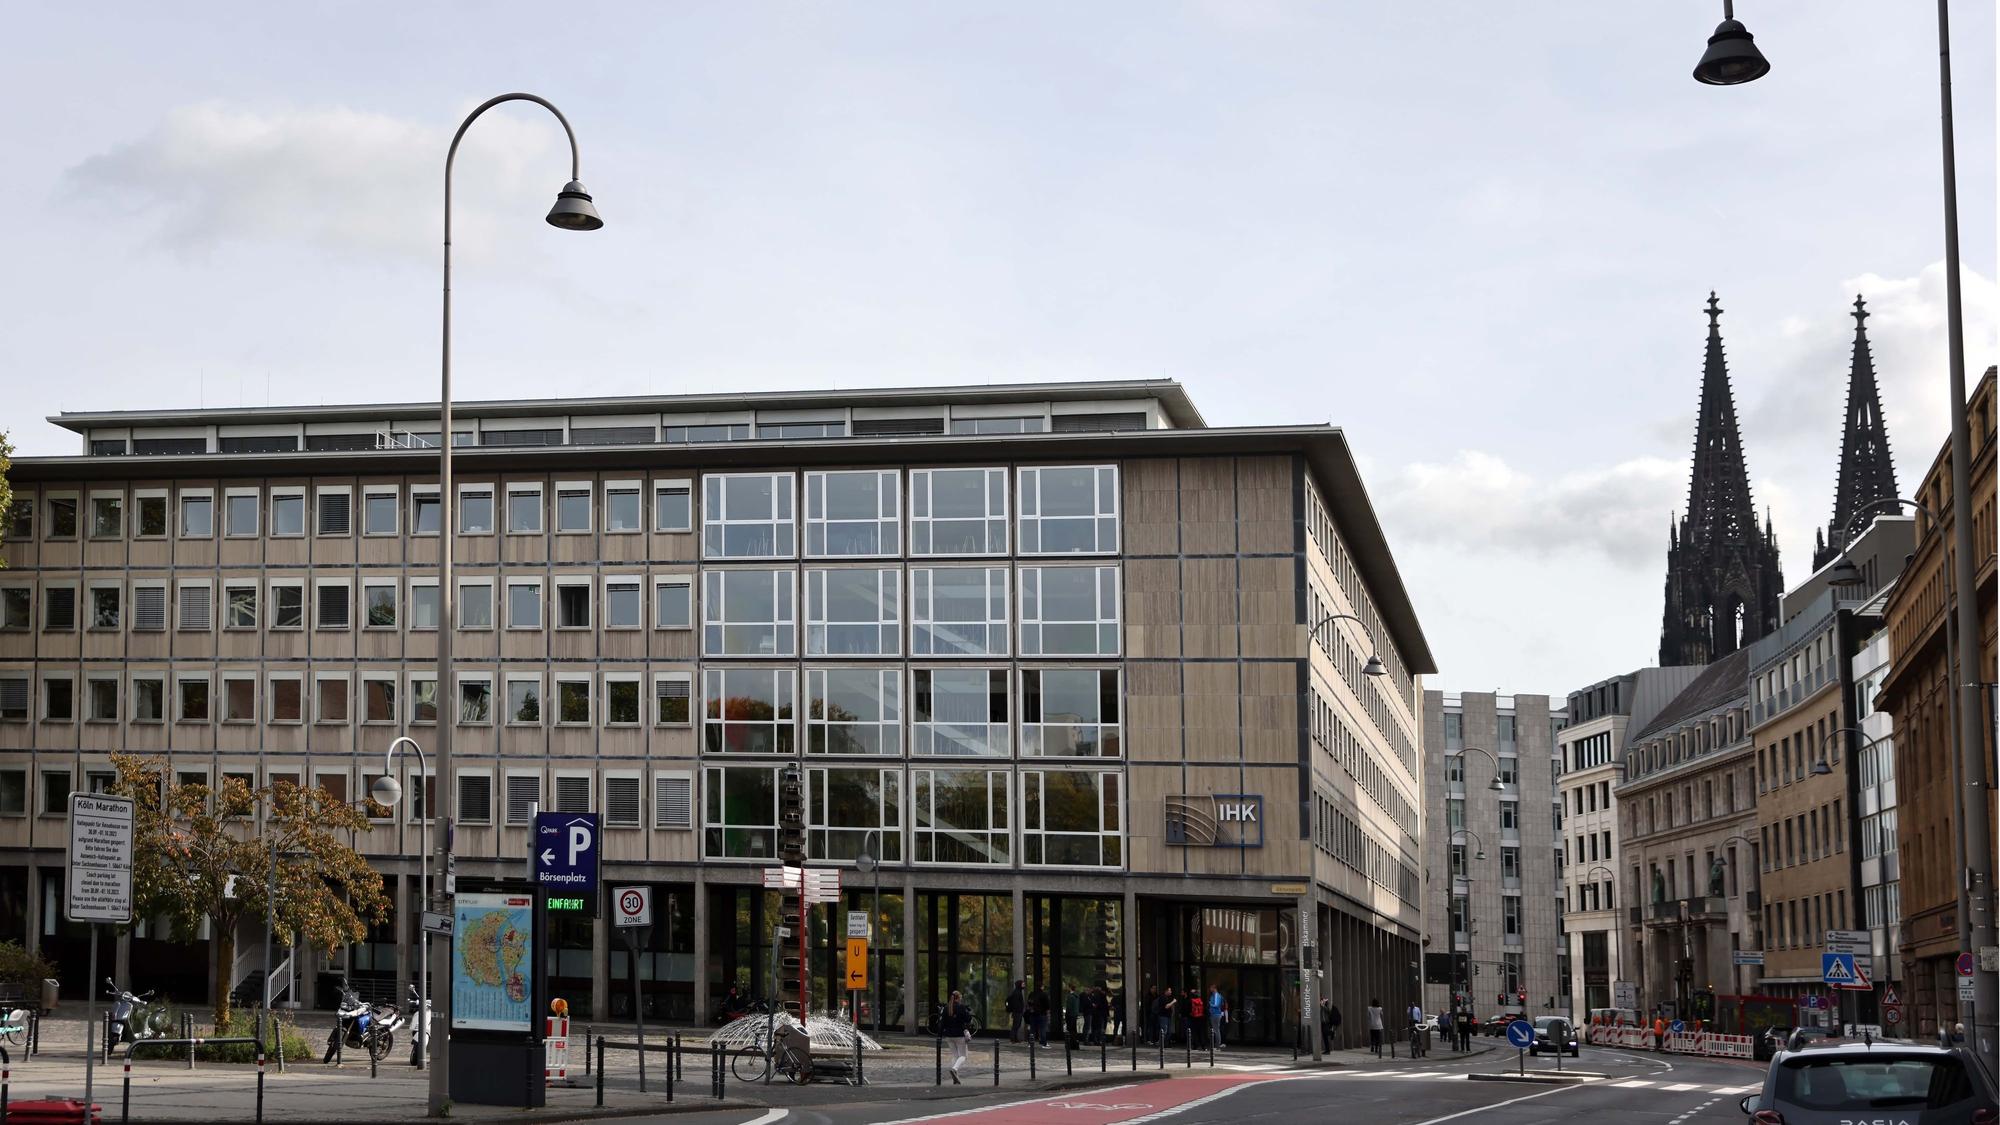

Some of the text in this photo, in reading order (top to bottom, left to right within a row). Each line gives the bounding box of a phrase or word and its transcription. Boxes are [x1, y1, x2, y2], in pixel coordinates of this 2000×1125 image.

[78, 800, 128, 812] Köln Marathon
[1220, 804, 1256, 821] IHK
[569, 826, 591, 866] P
[540, 872, 586, 884] Börsenplatz
[548, 898, 584, 910] EINFAHRT
[625, 897, 639, 908] 30
[854, 946, 859, 957] U
